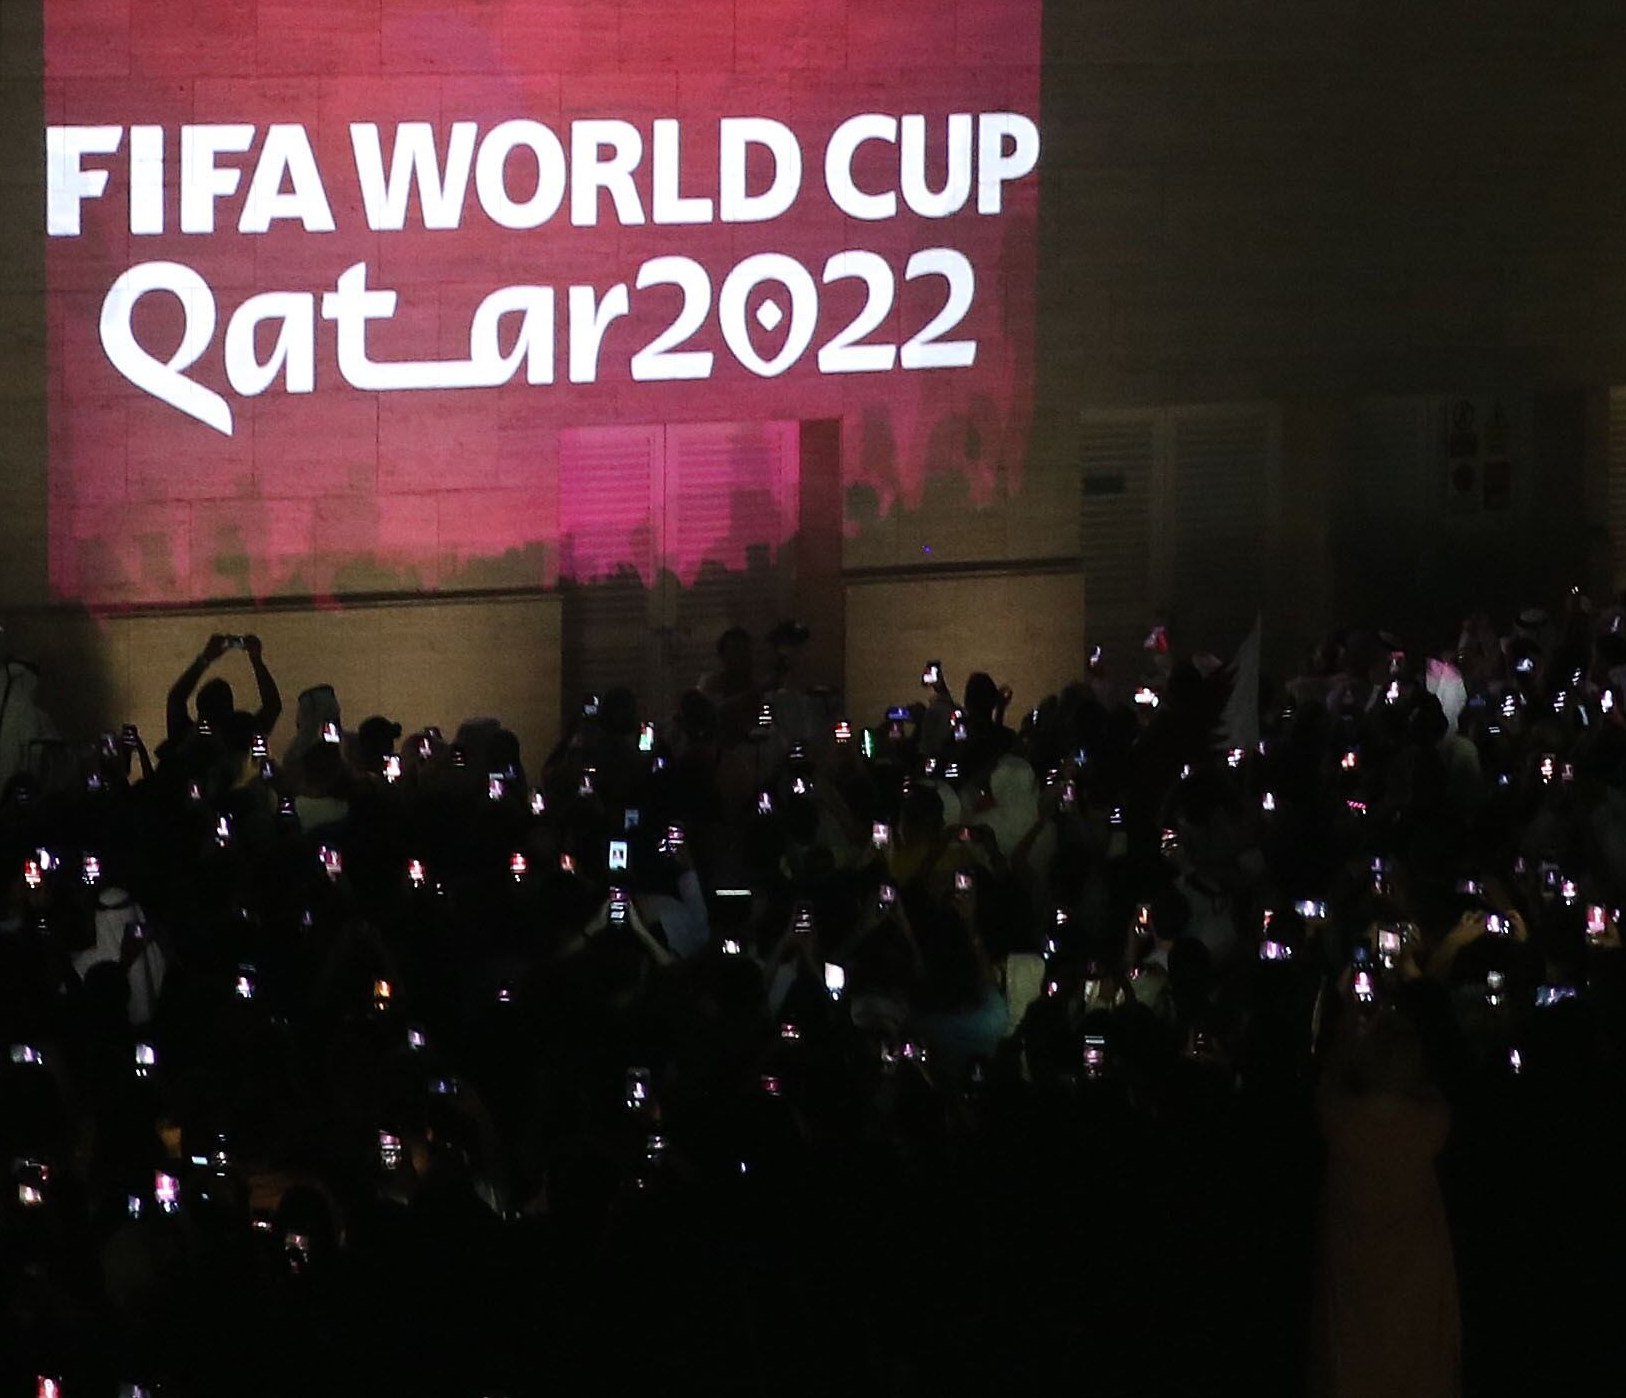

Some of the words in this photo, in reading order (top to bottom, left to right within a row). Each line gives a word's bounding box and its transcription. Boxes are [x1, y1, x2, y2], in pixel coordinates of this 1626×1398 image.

[46, 123, 336, 236] FIFA
[349, 117, 802, 231] WORLD
[824, 112, 1040, 220] CUP
